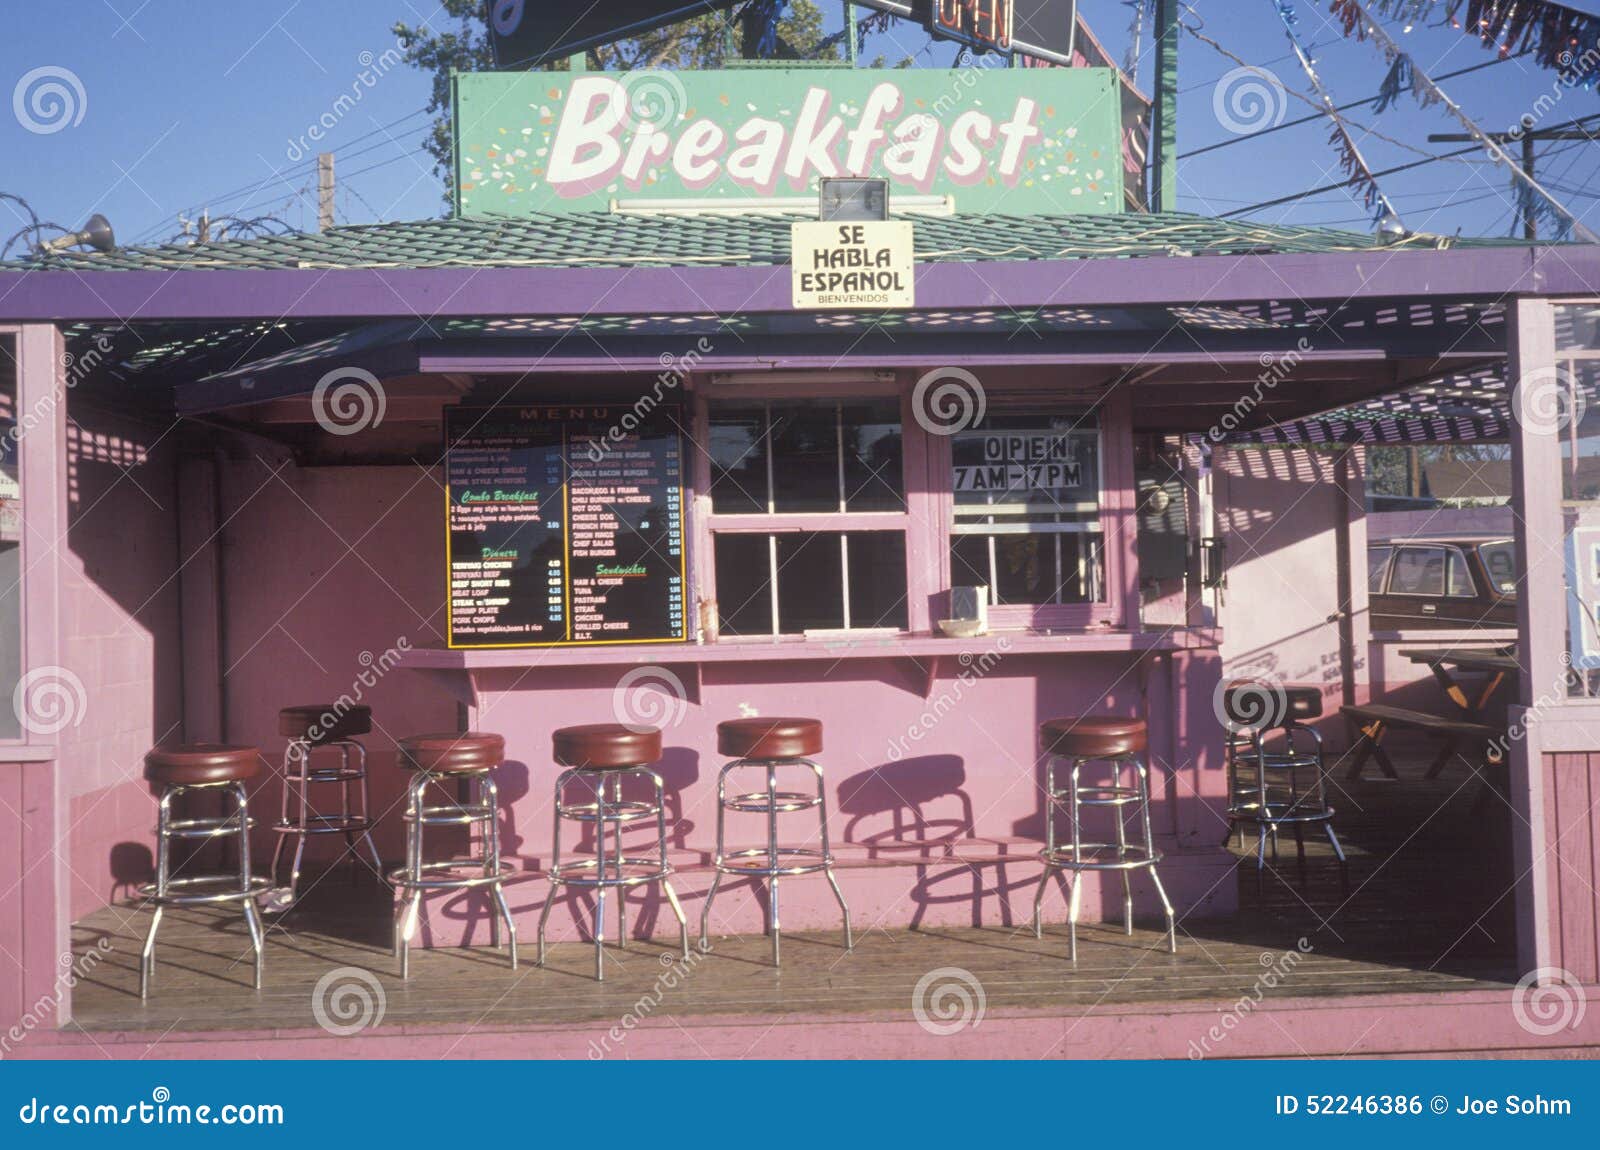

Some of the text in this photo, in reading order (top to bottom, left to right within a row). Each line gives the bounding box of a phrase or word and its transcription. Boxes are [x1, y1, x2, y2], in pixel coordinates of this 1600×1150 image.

[544, 76, 1042, 192] Breakfast
[838, 225, 865, 244] SE
[813, 248, 891, 270] HABLA
[800, 267, 904, 293] ESPAÑOL
[818, 294, 889, 304] BIENVENIDOS
[520, 408, 608, 419] MENU
[986, 436, 1067, 459] OPEN
[461, 490, 539, 503] Combo Breakfast
[481, 547, 518, 559] Dinners
[596, 563, 647, 575] Sandwiches
[574, 605, 596, 613] STEAK
[575, 614, 603, 622] CHICKEN
